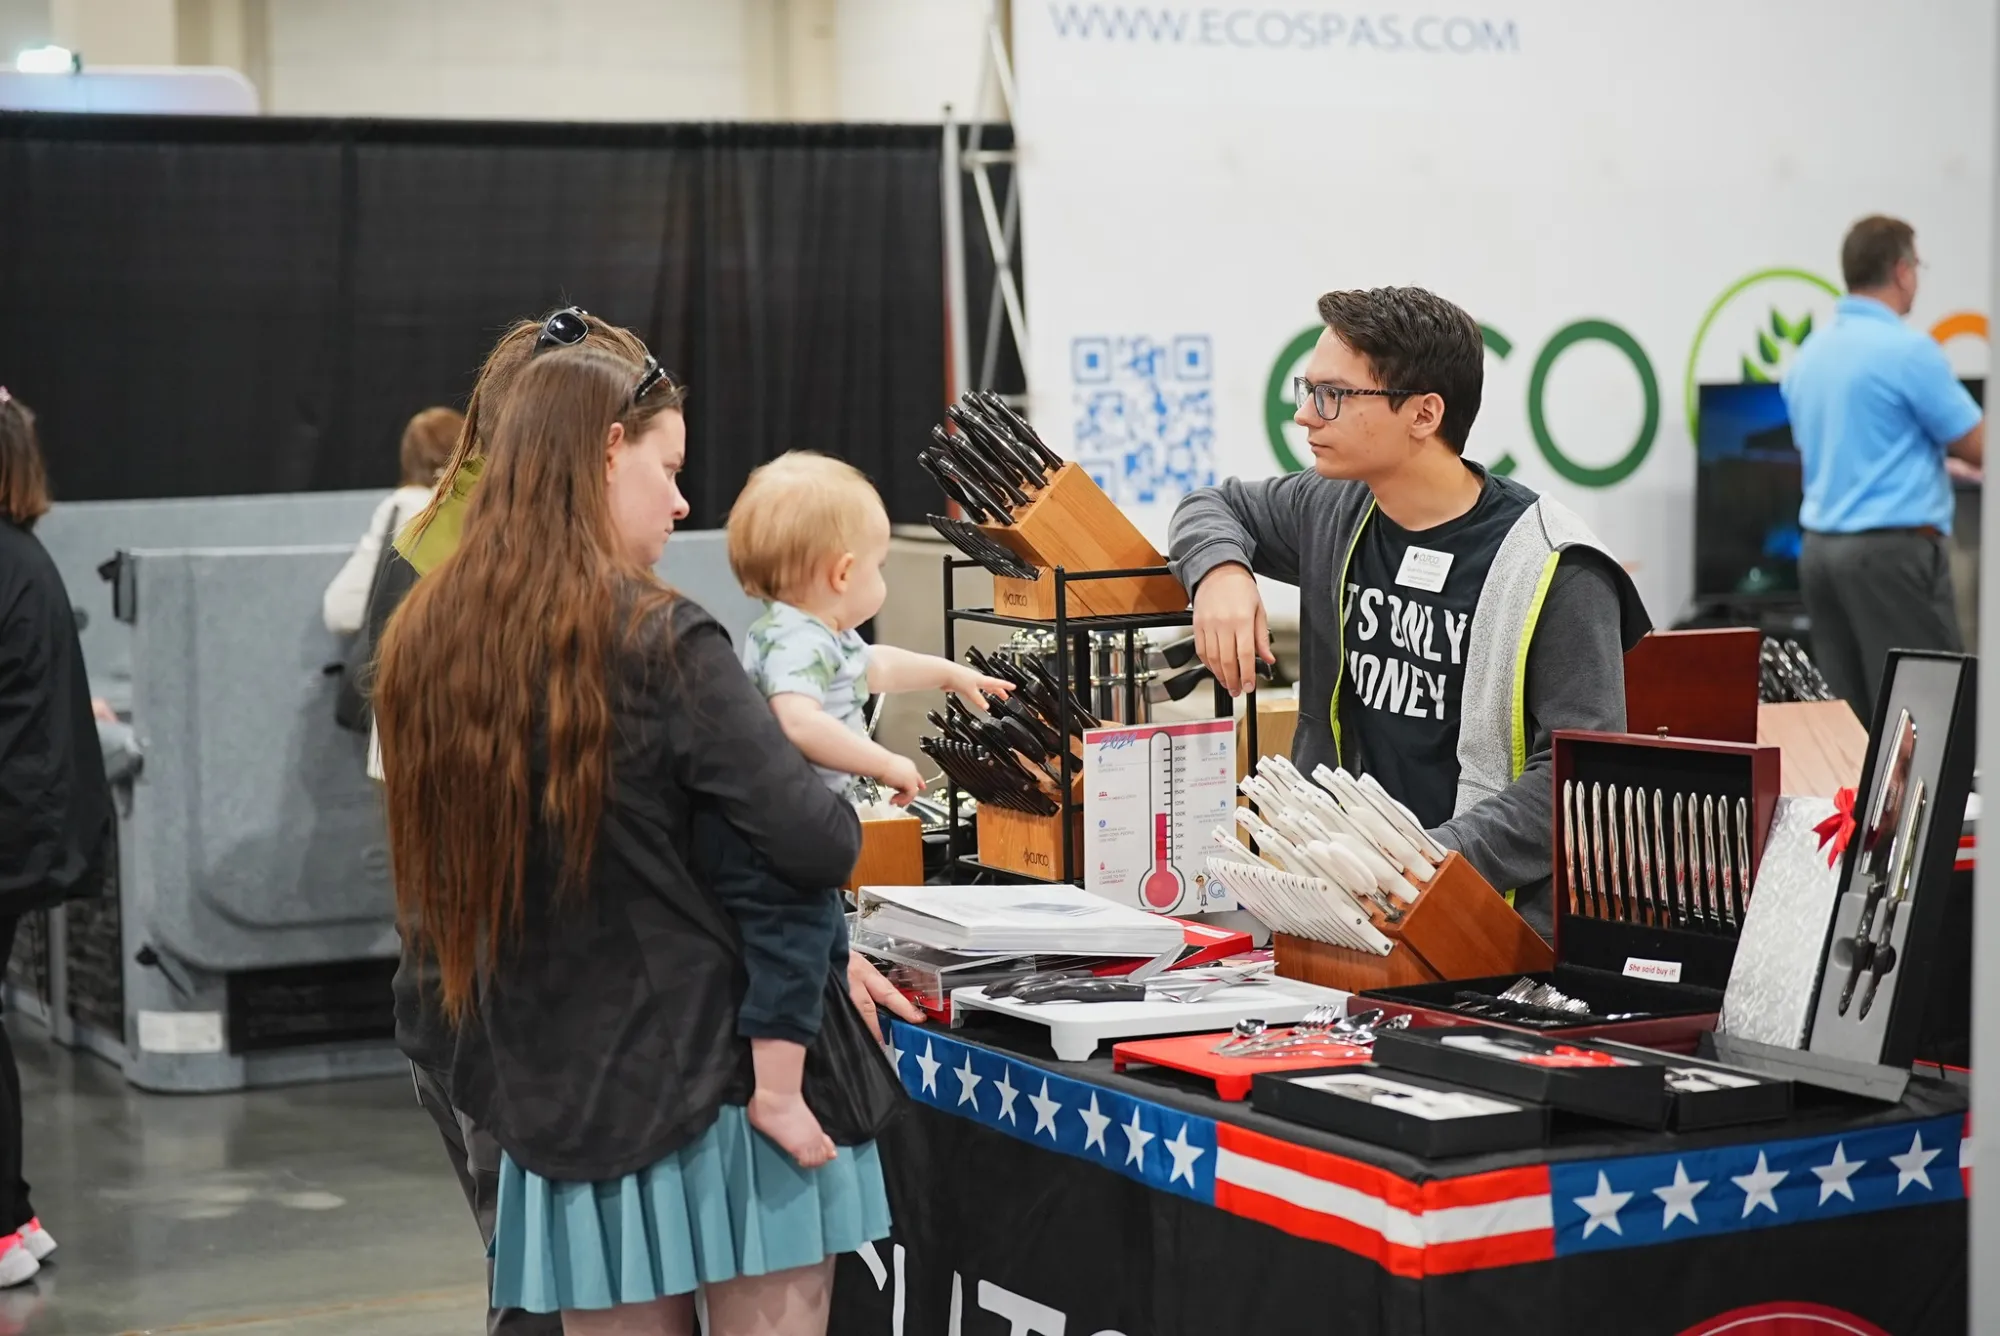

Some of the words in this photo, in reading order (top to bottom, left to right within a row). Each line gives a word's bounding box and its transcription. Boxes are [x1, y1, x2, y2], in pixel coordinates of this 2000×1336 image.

[1048, 3, 1521, 53] WWW.ECOSPAS.COM
[1387, 595, 1468, 664] ONLY
[1100, 733, 1137, 751] 2024
[1629, 964, 1641, 972] She
[1642, 965, 1655, 974] said
[1656, 967, 1668, 977] buy
